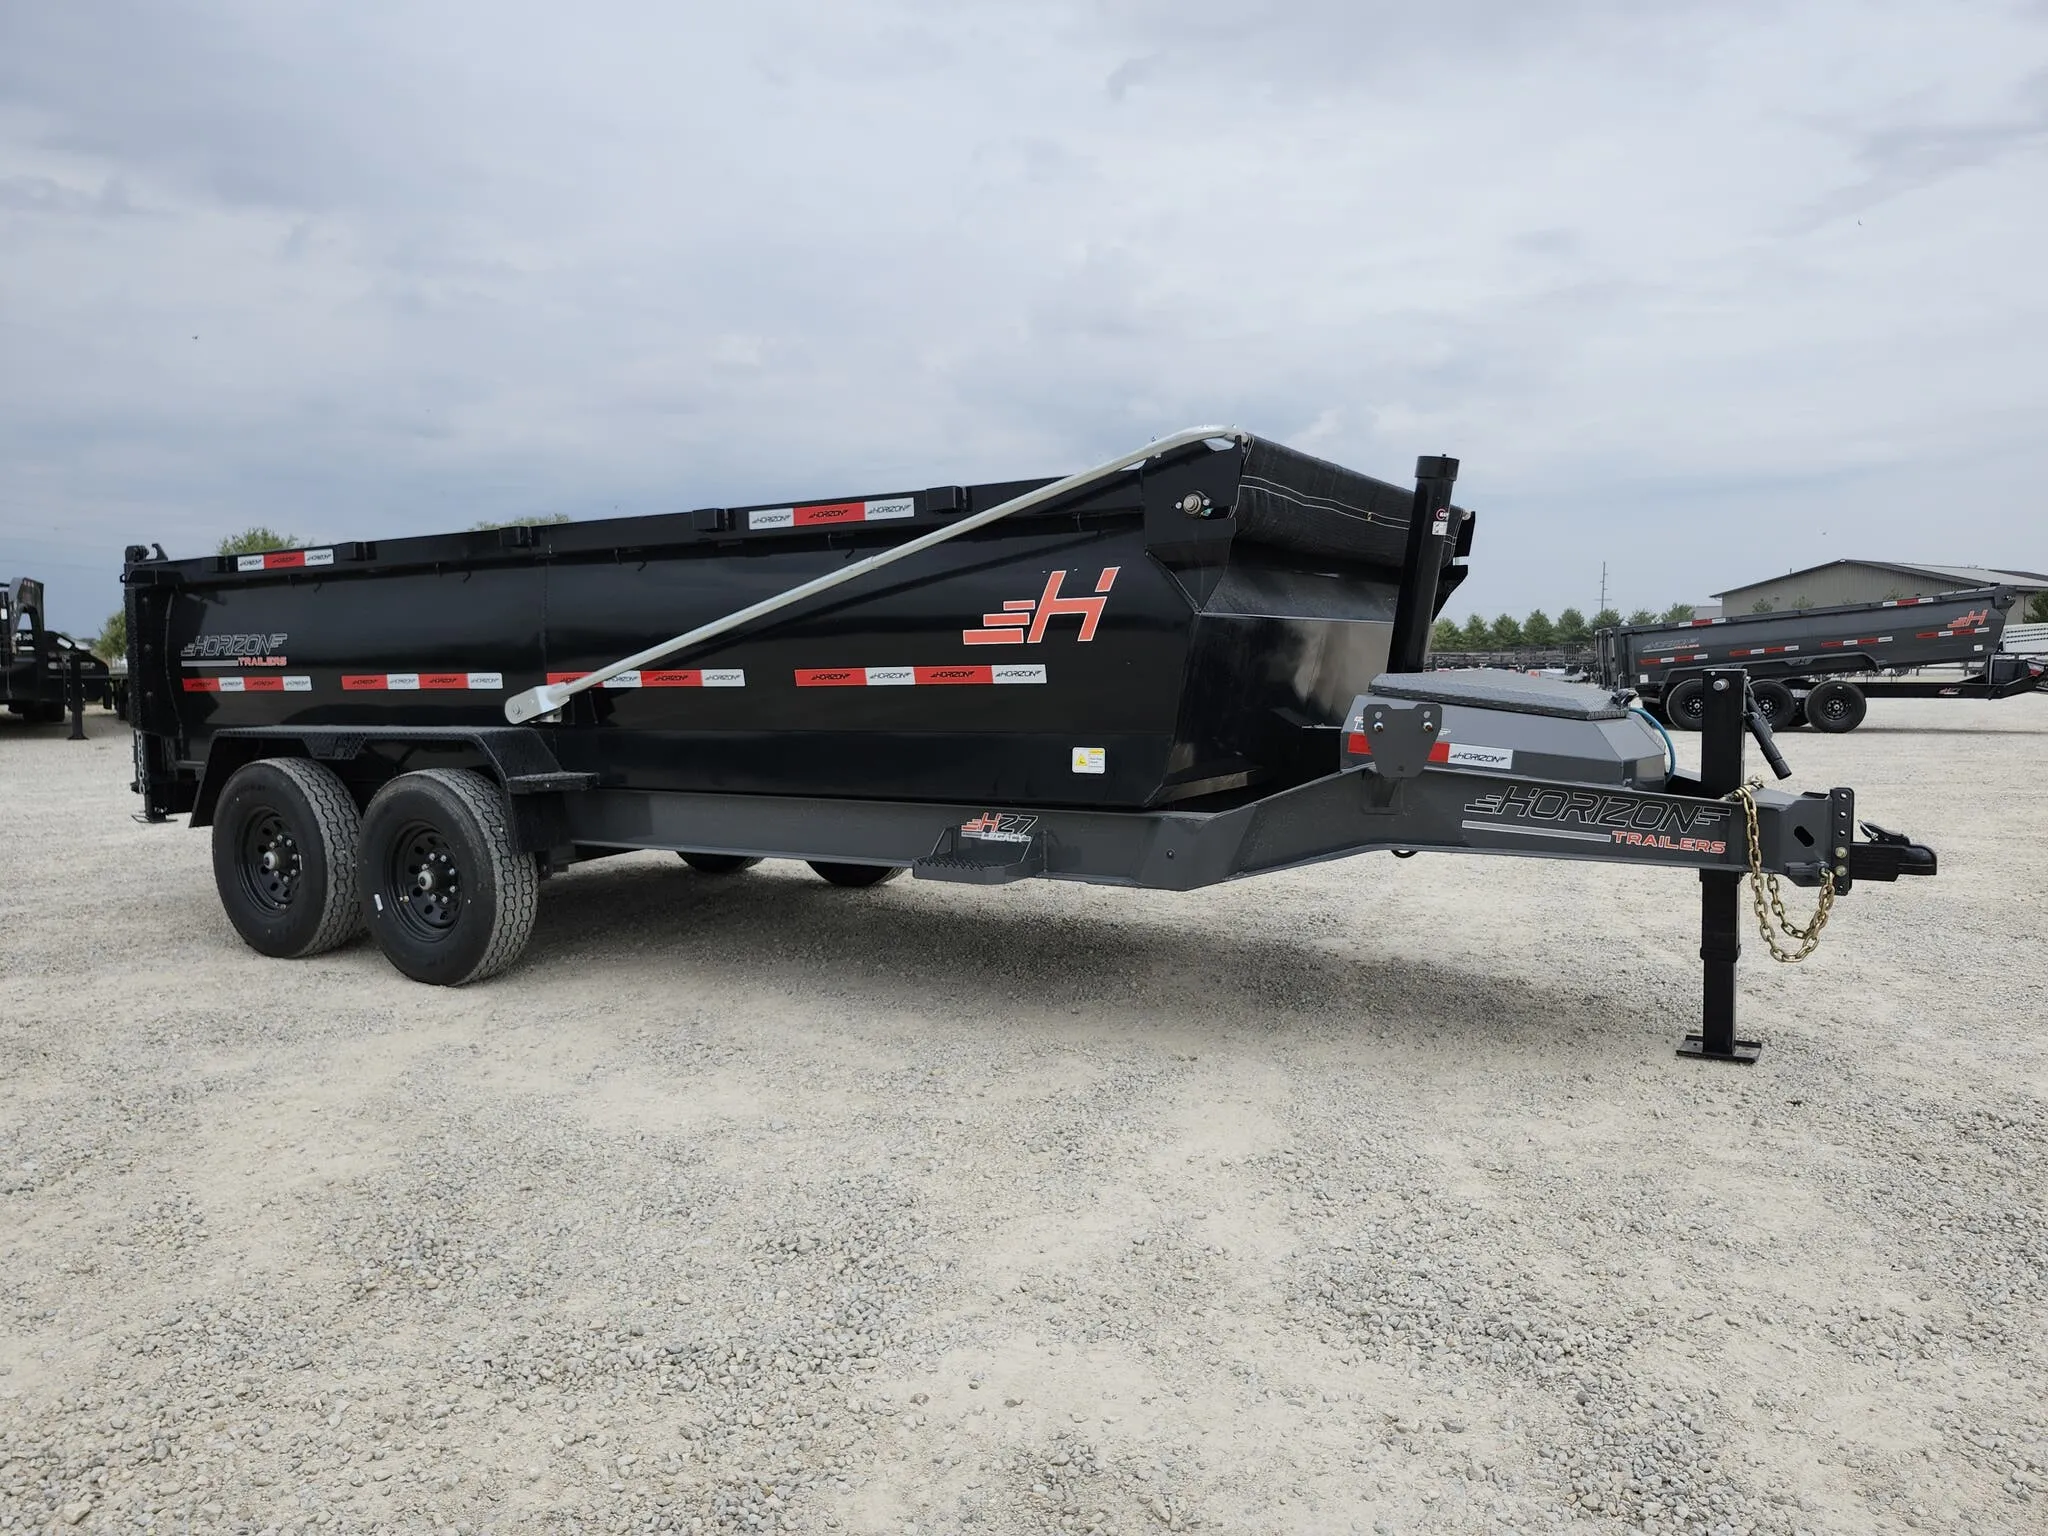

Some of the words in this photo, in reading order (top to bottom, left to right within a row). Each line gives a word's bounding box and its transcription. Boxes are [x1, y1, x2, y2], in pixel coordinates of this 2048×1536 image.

[812, 508, 847, 519] HORIZON
[871, 505, 909, 514] HORIZON
[194, 634, 272, 656] HORIZON
[238, 656, 287, 666] TRAILERS
[814, 673, 848, 682] HORIZON
[872, 672, 909, 680] HORIZON
[933, 670, 973, 679] HORIZON
[1000, 670, 1038, 679] HORIZON
[1456, 751, 1502, 763] HORIZON
[1495, 785, 1700, 834] HORIZON
[980, 811, 1039, 835] H27
[1612, 830, 1726, 854] TRAILERS
